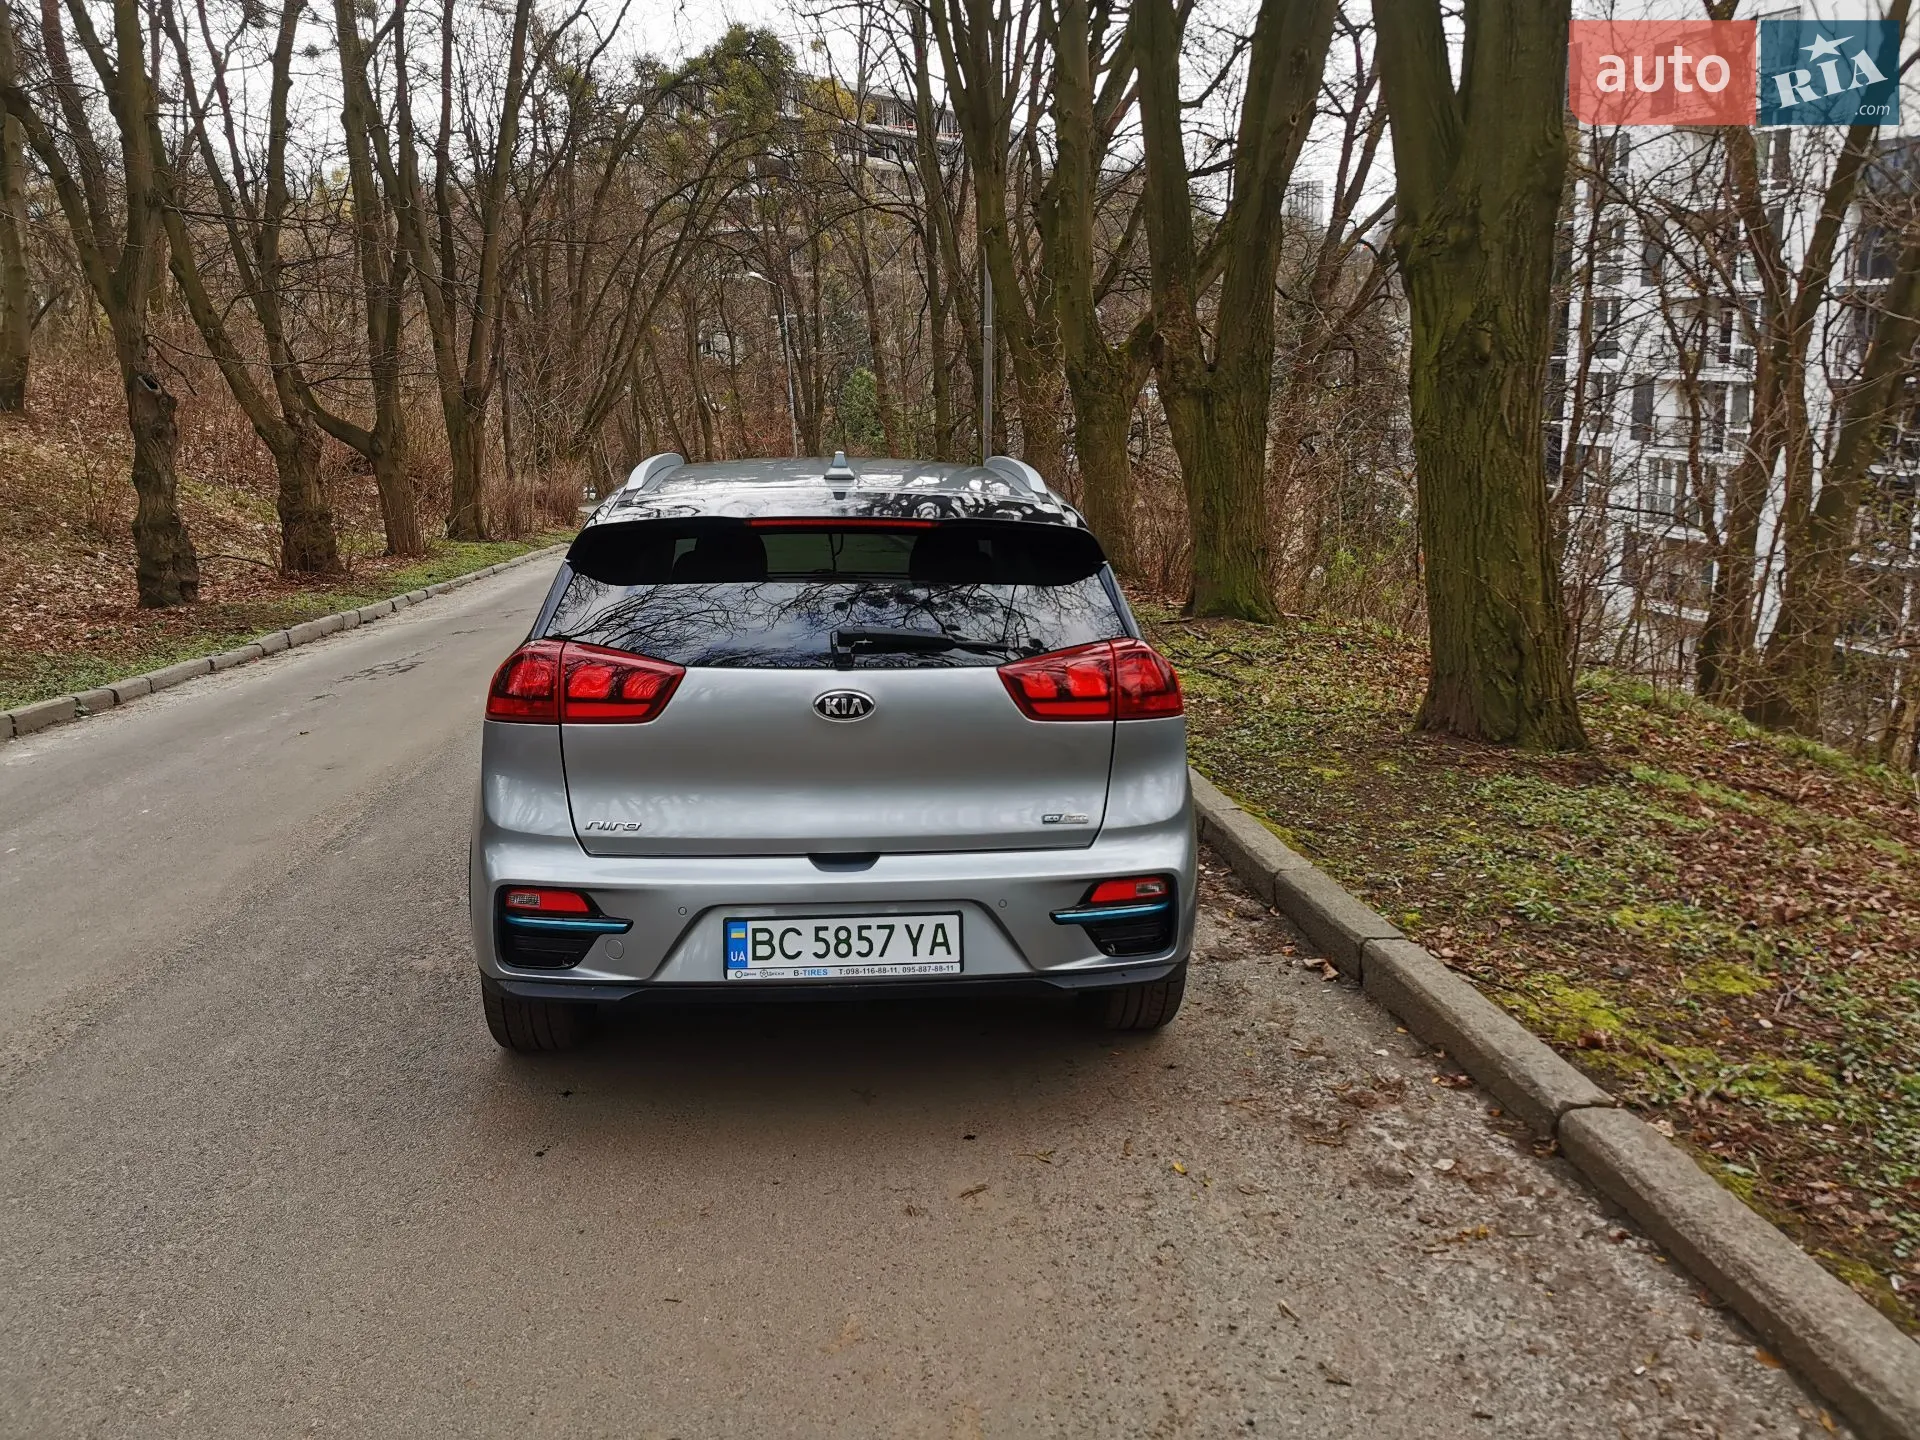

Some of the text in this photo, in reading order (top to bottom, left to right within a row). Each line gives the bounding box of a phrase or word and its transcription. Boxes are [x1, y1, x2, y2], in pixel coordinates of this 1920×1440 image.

[824, 697, 865, 715] KIA
[751, 923, 952, 961] BC 5857 YA
[730, 951, 746, 962] UA
[793, 968, 828, 977] B-TIRES
